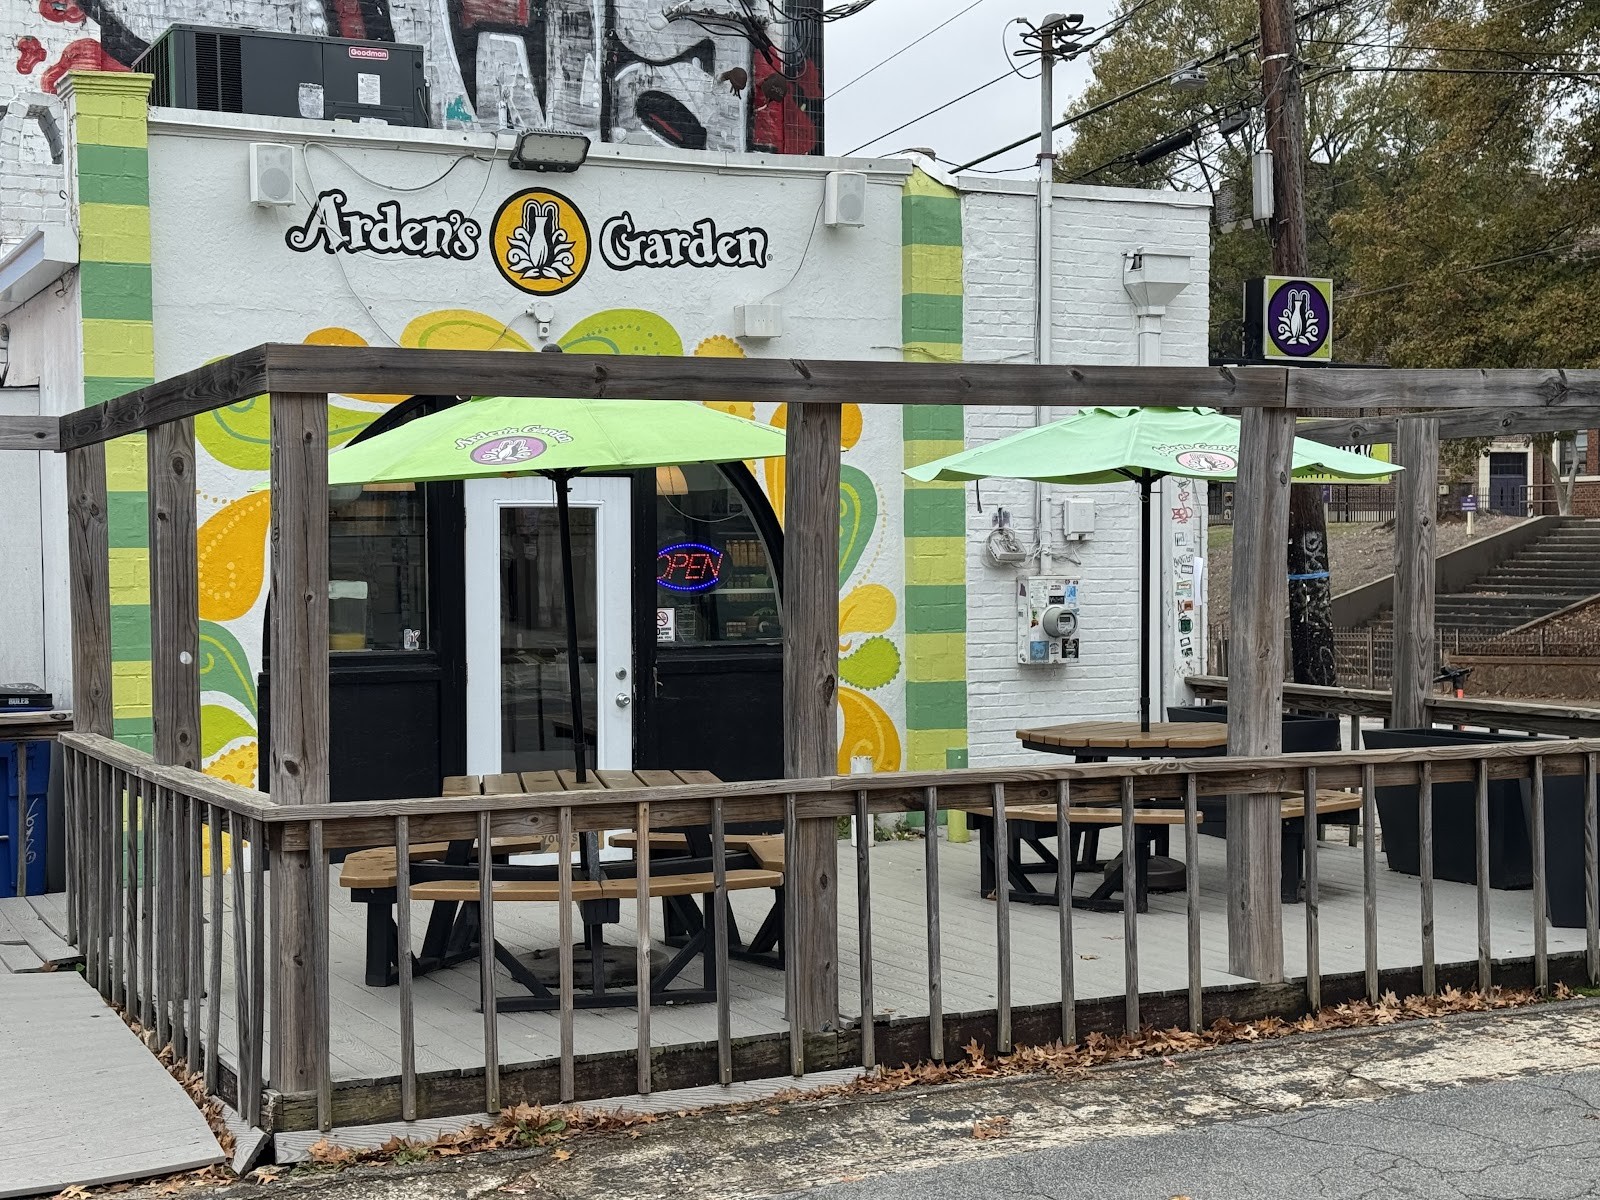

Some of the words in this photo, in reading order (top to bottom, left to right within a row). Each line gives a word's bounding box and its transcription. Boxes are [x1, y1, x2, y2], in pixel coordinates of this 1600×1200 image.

[350, 48, 387, 58] Goodman
[285, 189, 481, 260] Arden's
[599, 211, 768, 271] Garden
[455, 427, 519, 450] Arden's
[657, 553, 723, 579] OPEN
